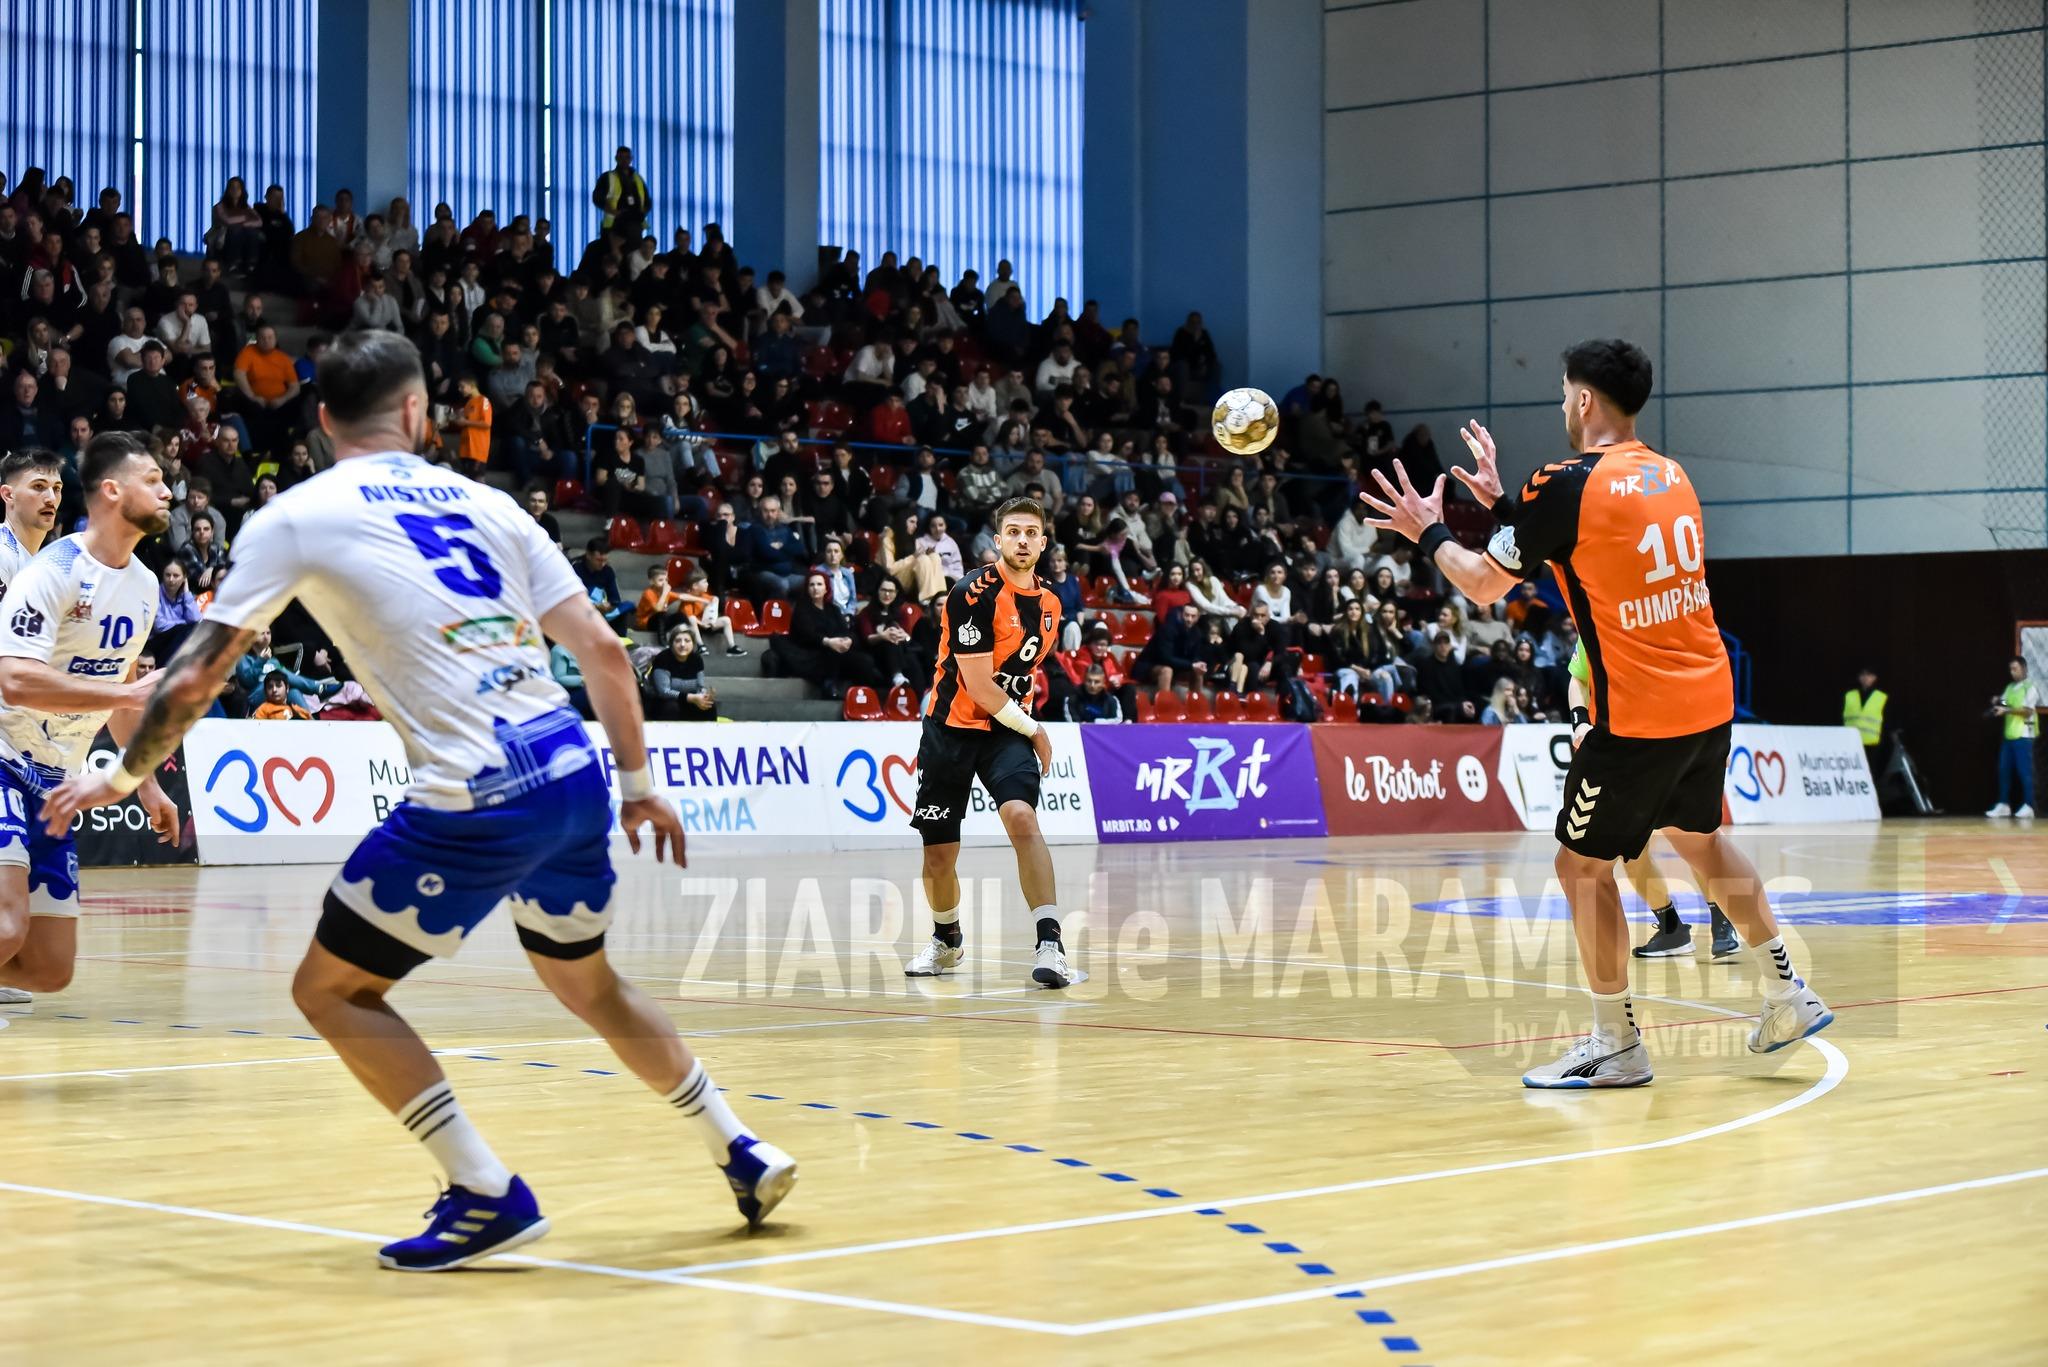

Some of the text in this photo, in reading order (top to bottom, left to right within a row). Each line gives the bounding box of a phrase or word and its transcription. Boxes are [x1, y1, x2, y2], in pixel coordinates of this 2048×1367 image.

[359, 485, 470, 503] NISTOR
[394, 513, 503, 600] 5
[1637, 515, 1700, 585] 10
[99, 614, 133, 649] 10
[1020, 636, 1039, 661] 6
[601, 745, 810, 787] PTERMAN
[1344, 755, 1446, 804] le Bistrot
[1798, 753, 1863, 776] Municipiul
[1803, 777, 1870, 796] Baia Mare
[1102, 819, 1151, 833] MRBIT.RO
